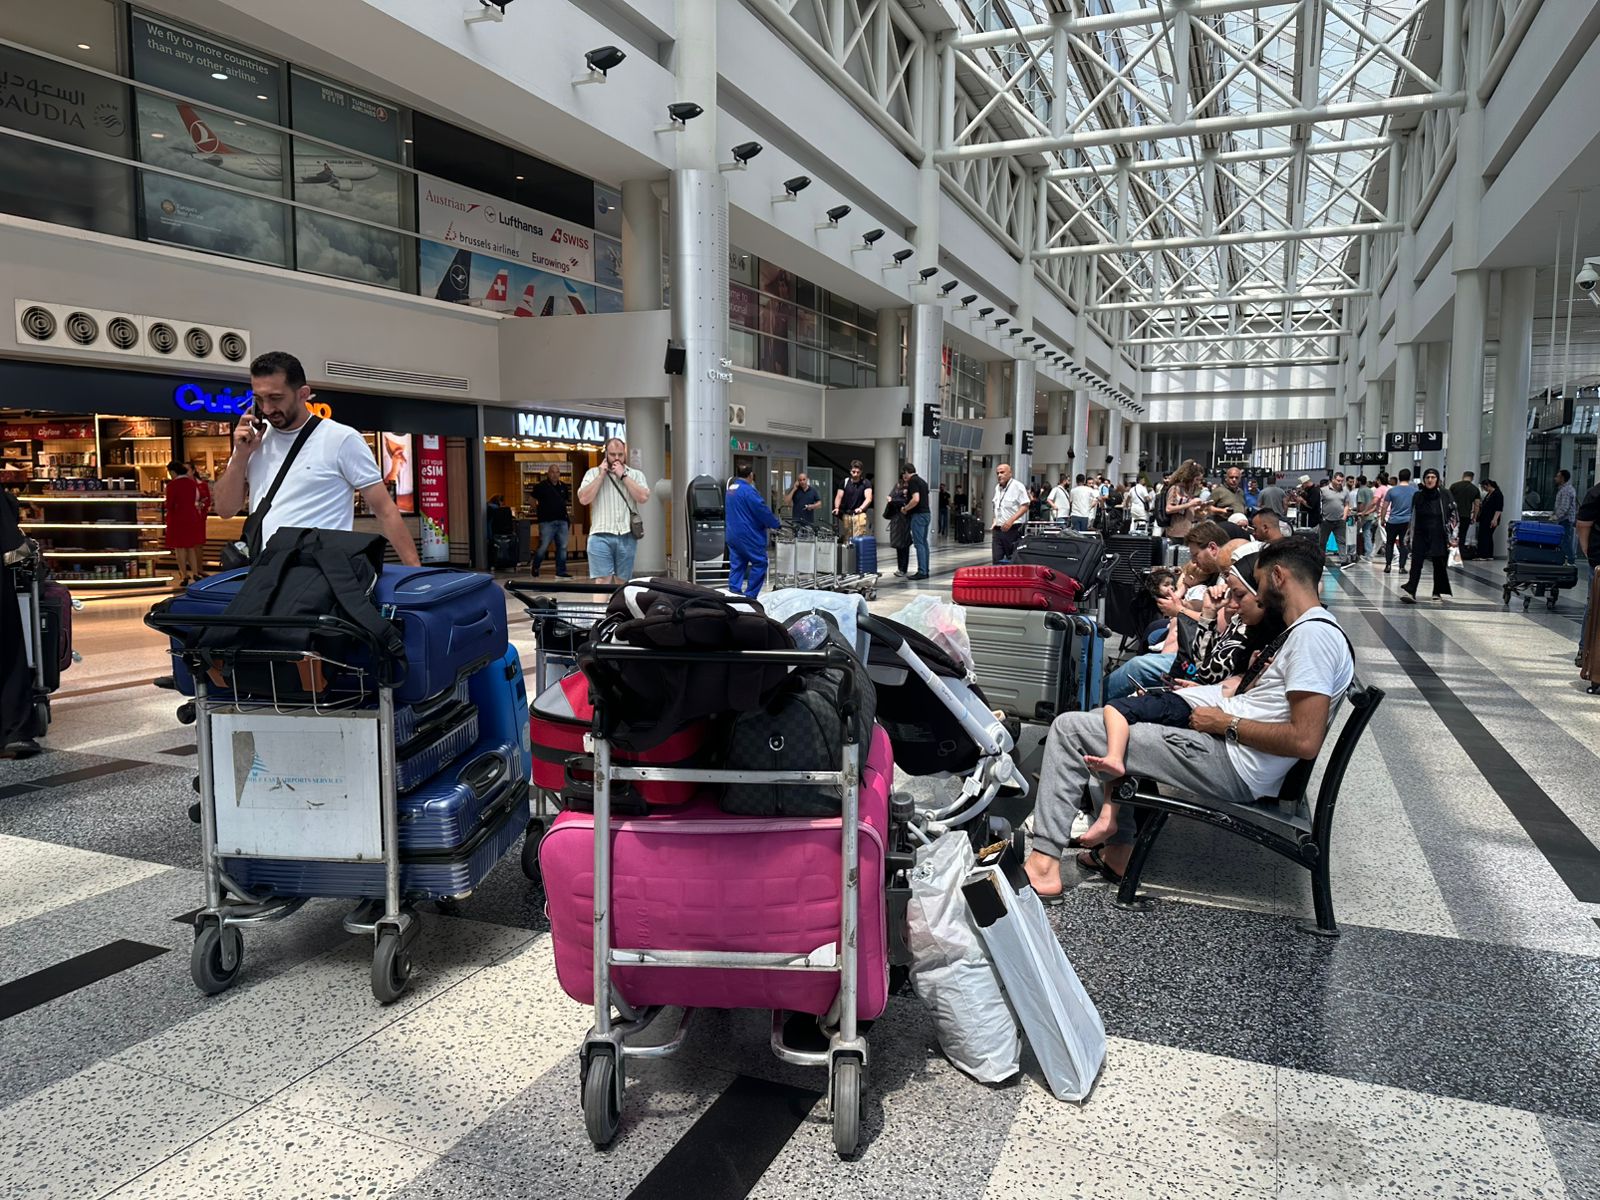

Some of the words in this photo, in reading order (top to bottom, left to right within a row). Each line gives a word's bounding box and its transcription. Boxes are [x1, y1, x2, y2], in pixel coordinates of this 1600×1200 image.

[146, 23, 164, 38] We
[166, 31, 180, 46] fly
[182, 37, 194, 48] to
[195, 43, 222, 58] more
[223, 53, 269, 75] countries
[147, 38, 173, 56] than
[175, 50, 194, 64] any
[196, 56, 223, 73] other
[225, 66, 259, 85] airline.
[0, 71, 85, 106] السعودي
[0, 94, 86, 130] AUDIA
[425, 189, 467, 212] Austrian
[499, 212, 543, 237] Lufthansa
[459, 231, 491, 252] brussels
[492, 245, 520, 259] airlines
[563, 232, 589, 250] SWISS
[532, 251, 571, 273] Eurowings
[518, 412, 581, 440] MALAK
[582, 419, 605, 442] AL
[421, 465, 443, 476] eSIM
[421, 476, 437, 485] here
[312, 777, 343, 785] SERVICES
